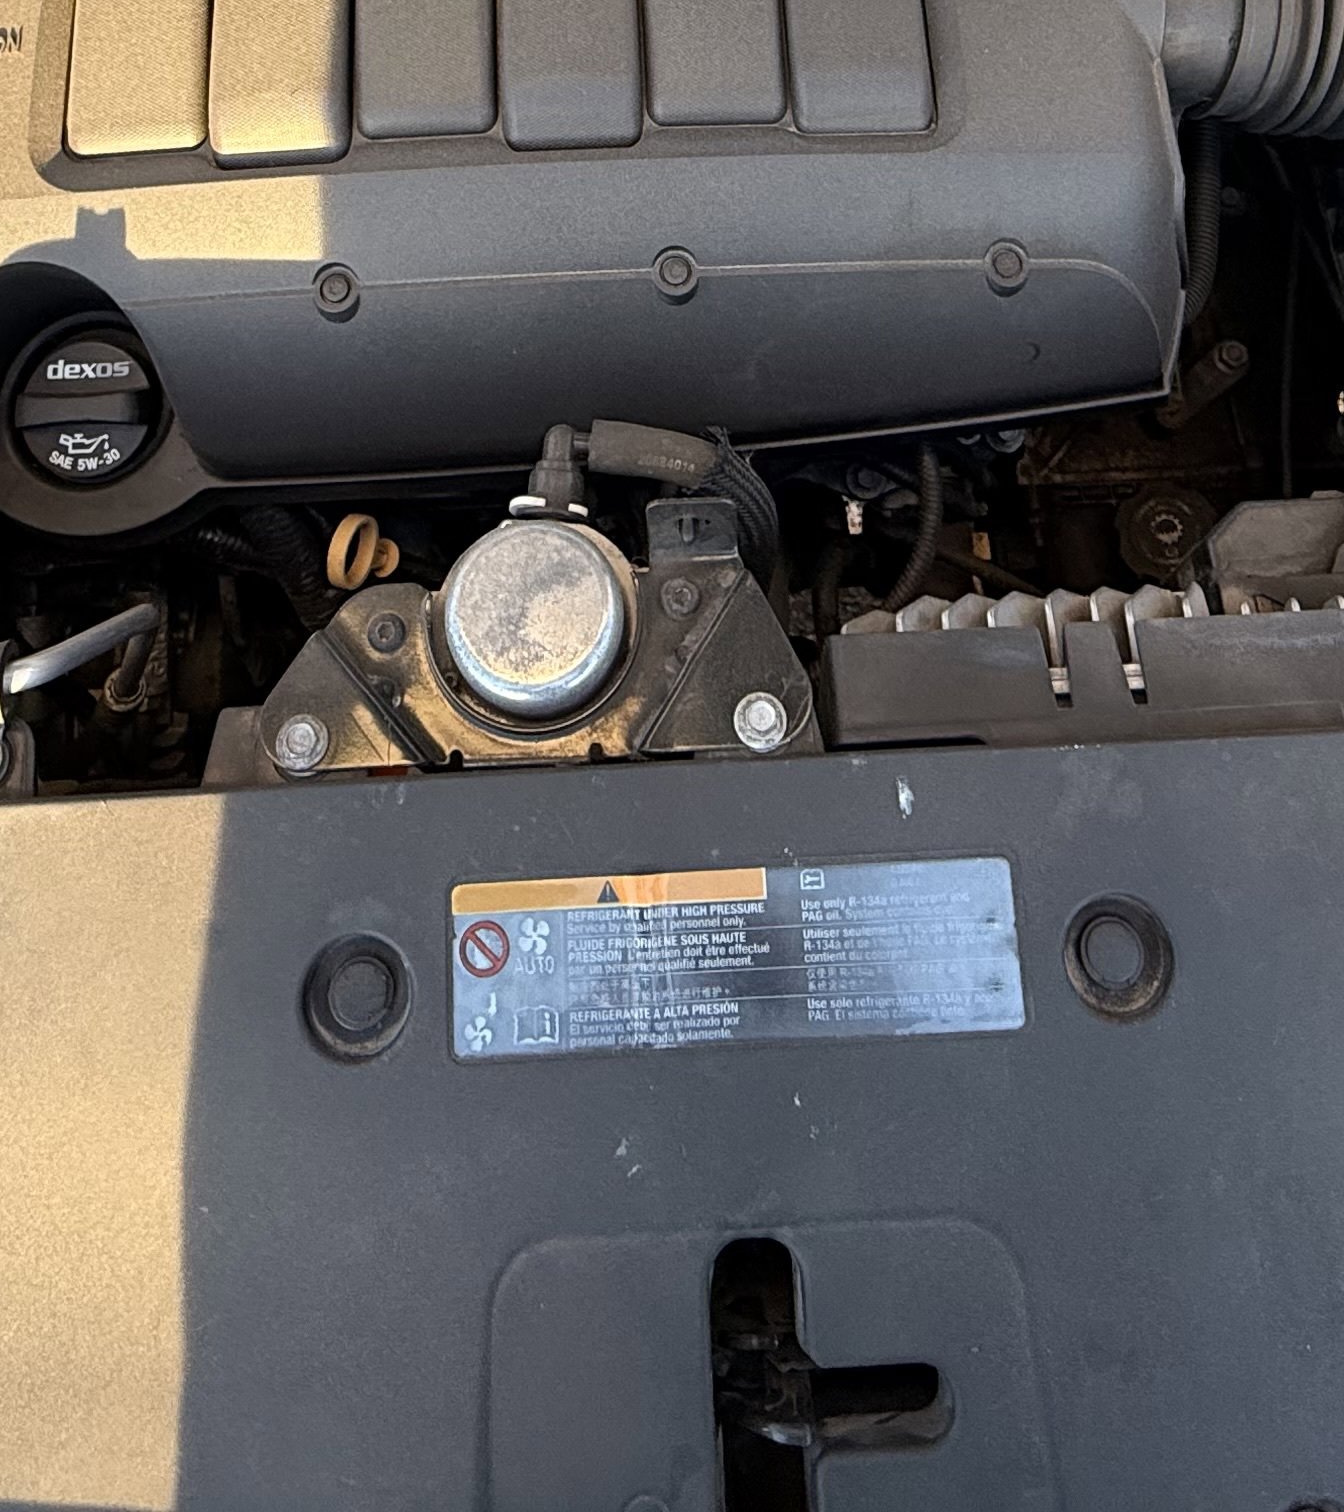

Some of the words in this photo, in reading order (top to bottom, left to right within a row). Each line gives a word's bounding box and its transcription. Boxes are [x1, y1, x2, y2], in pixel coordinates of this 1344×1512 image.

[46, 358, 134, 380] dexos
[48, 450, 74, 470] SAE
[77, 447, 121, 472] 5W-30
[800, 898, 821, 910] Use
[822, 896, 846, 911] only
[567, 908, 640, 923] REFRIGERANT
[643, 906, 678, 919] UNDER
[681, 905, 707, 917] HIGH
[709, 901, 765, 916] PRESSURE
[800, 910, 823, 922] PAG
[669, 916, 720, 931] personnel
[722, 914, 746, 929] only.
[802, 926, 840, 939] Utiliser
[567, 938, 605, 952] FLUIDE
[680, 933, 709, 946] SOUS
[711, 931, 746, 944] HAUTE
[683, 945, 703, 957] doit
[514, 955, 555, 975] AUTO
[698, 954, 754, 969] seulement.
[806, 996, 827, 1009] Use
[569, 1006, 651, 1024] REFRIGERANTE
[662, 1004, 689, 1018] ALTA
[722, 1015, 741, 1028] por
